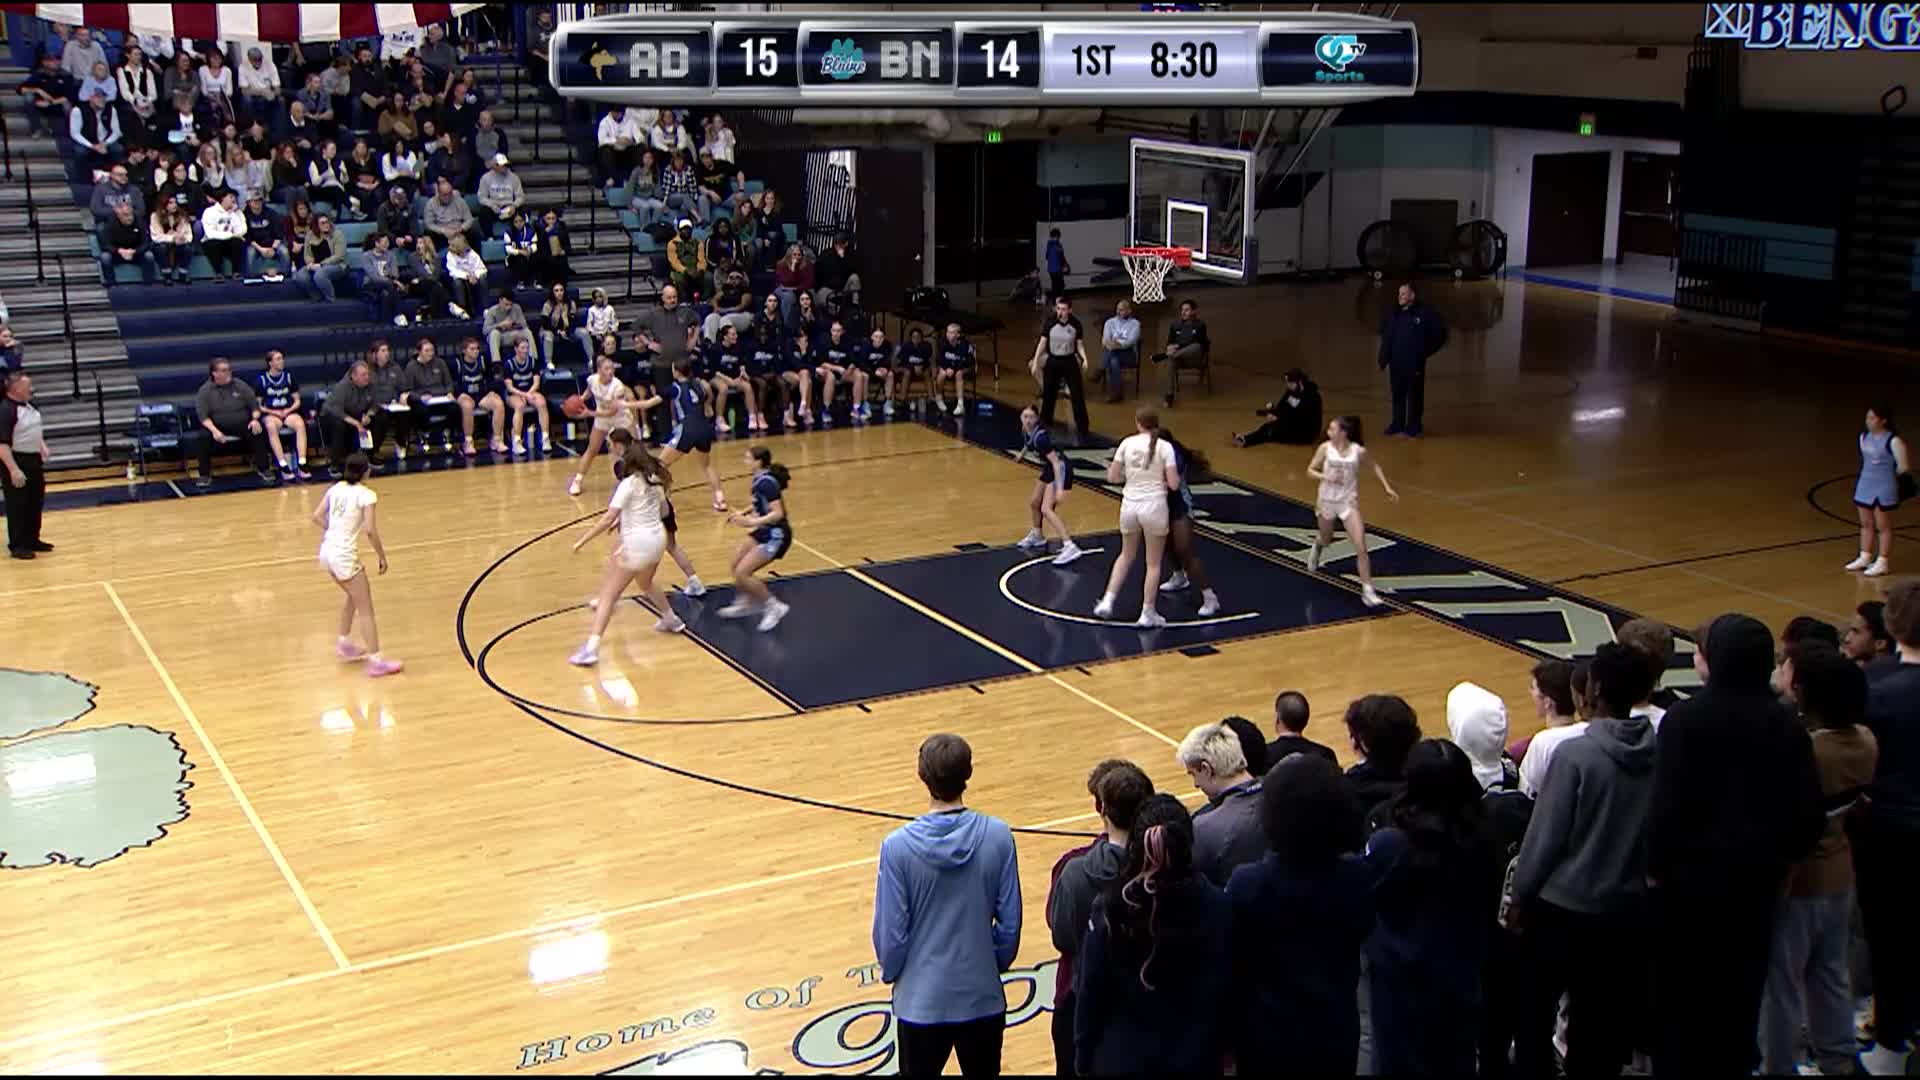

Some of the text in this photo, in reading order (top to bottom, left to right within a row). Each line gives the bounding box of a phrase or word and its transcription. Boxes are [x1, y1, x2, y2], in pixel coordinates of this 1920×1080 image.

[1744, 4, 1919, 49] BENG
[515, 1007, 716, 1070] Home
[745, 975, 824, 1010] Of
